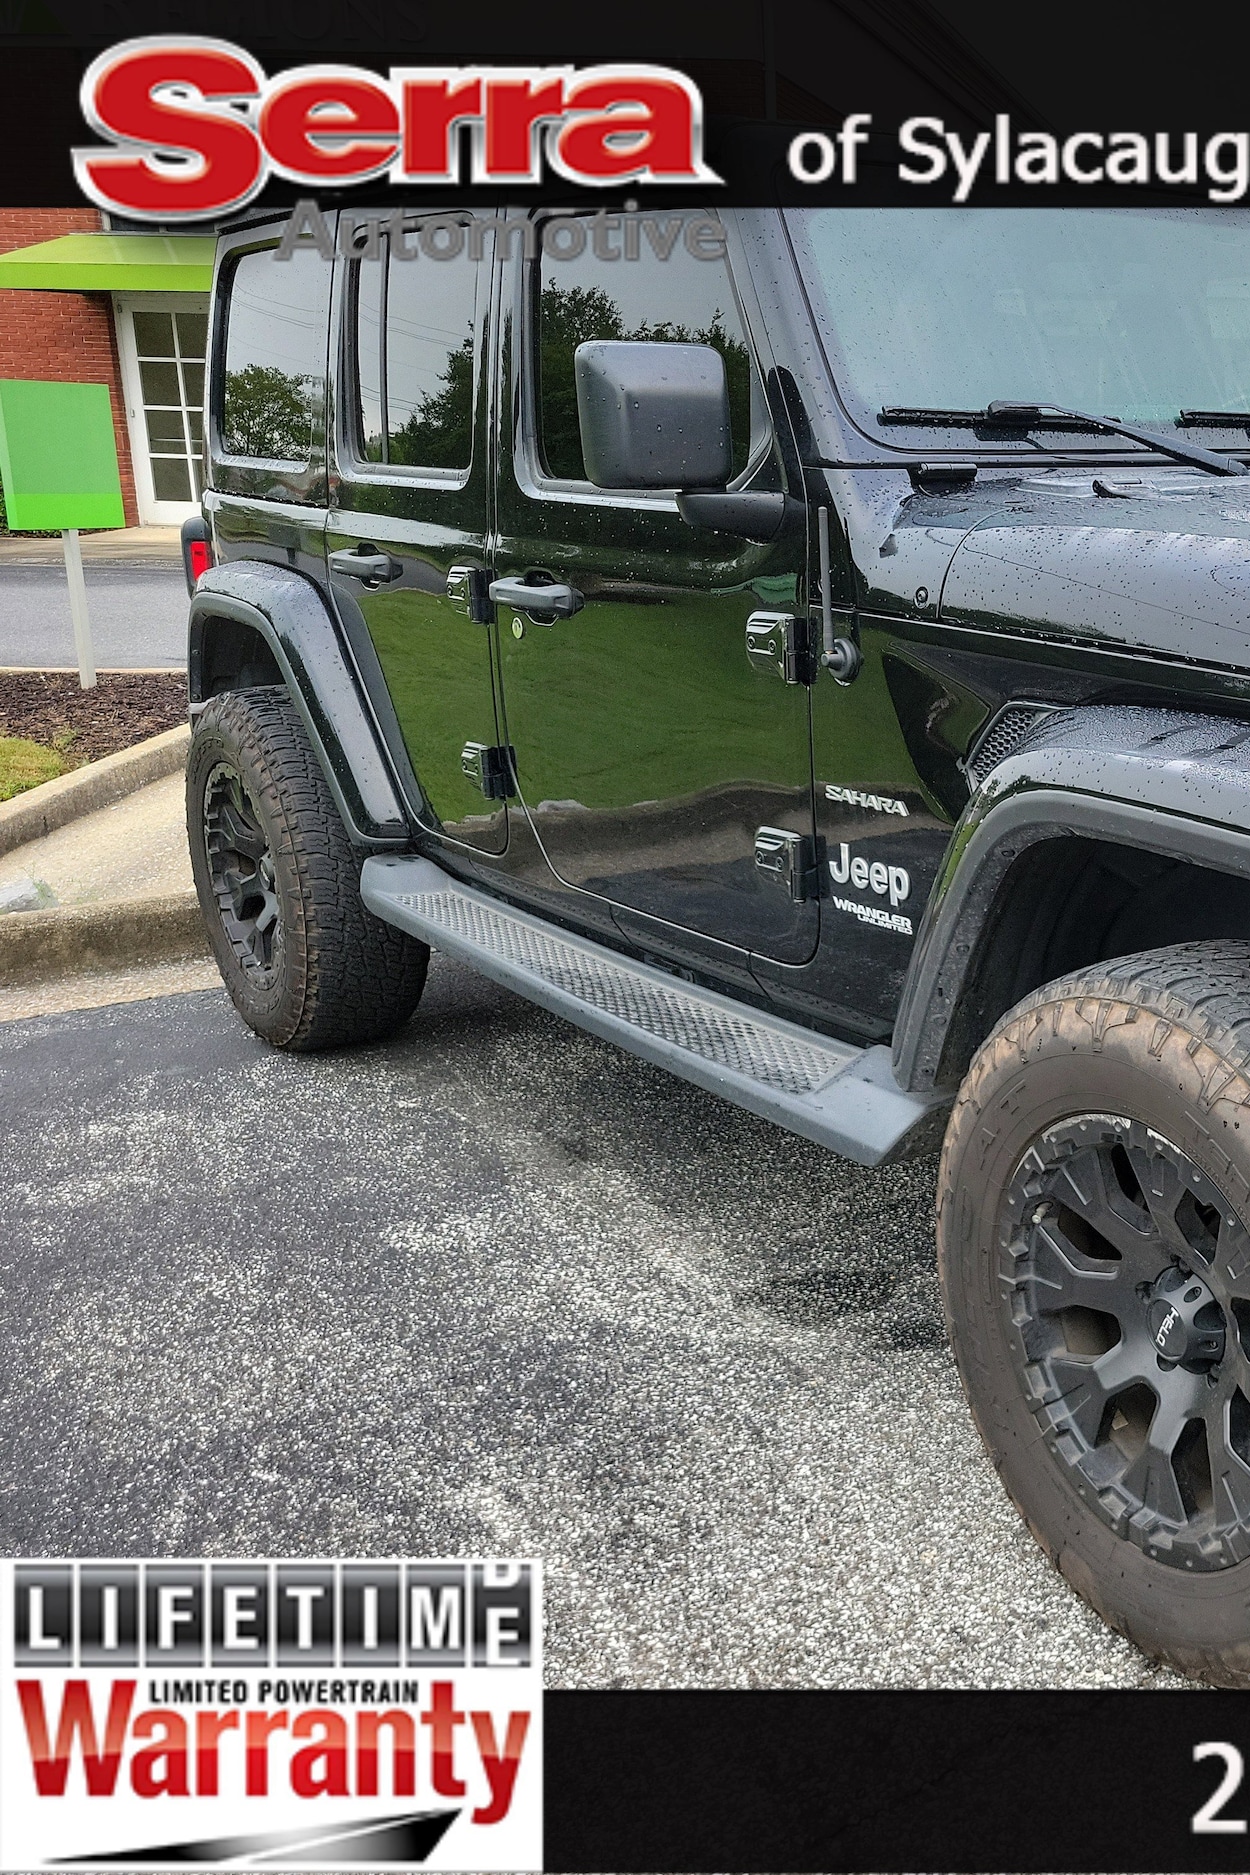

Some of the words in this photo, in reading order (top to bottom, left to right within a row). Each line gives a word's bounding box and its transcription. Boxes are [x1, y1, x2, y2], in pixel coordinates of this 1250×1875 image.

[825, 784, 910, 817] SAHARA
[828, 842, 911, 907] Jeep
[832, 895, 913, 930] WRANGLER
[857, 913, 913, 936] UNLIMITED
[1156, 1307, 1179, 1347] HELO
